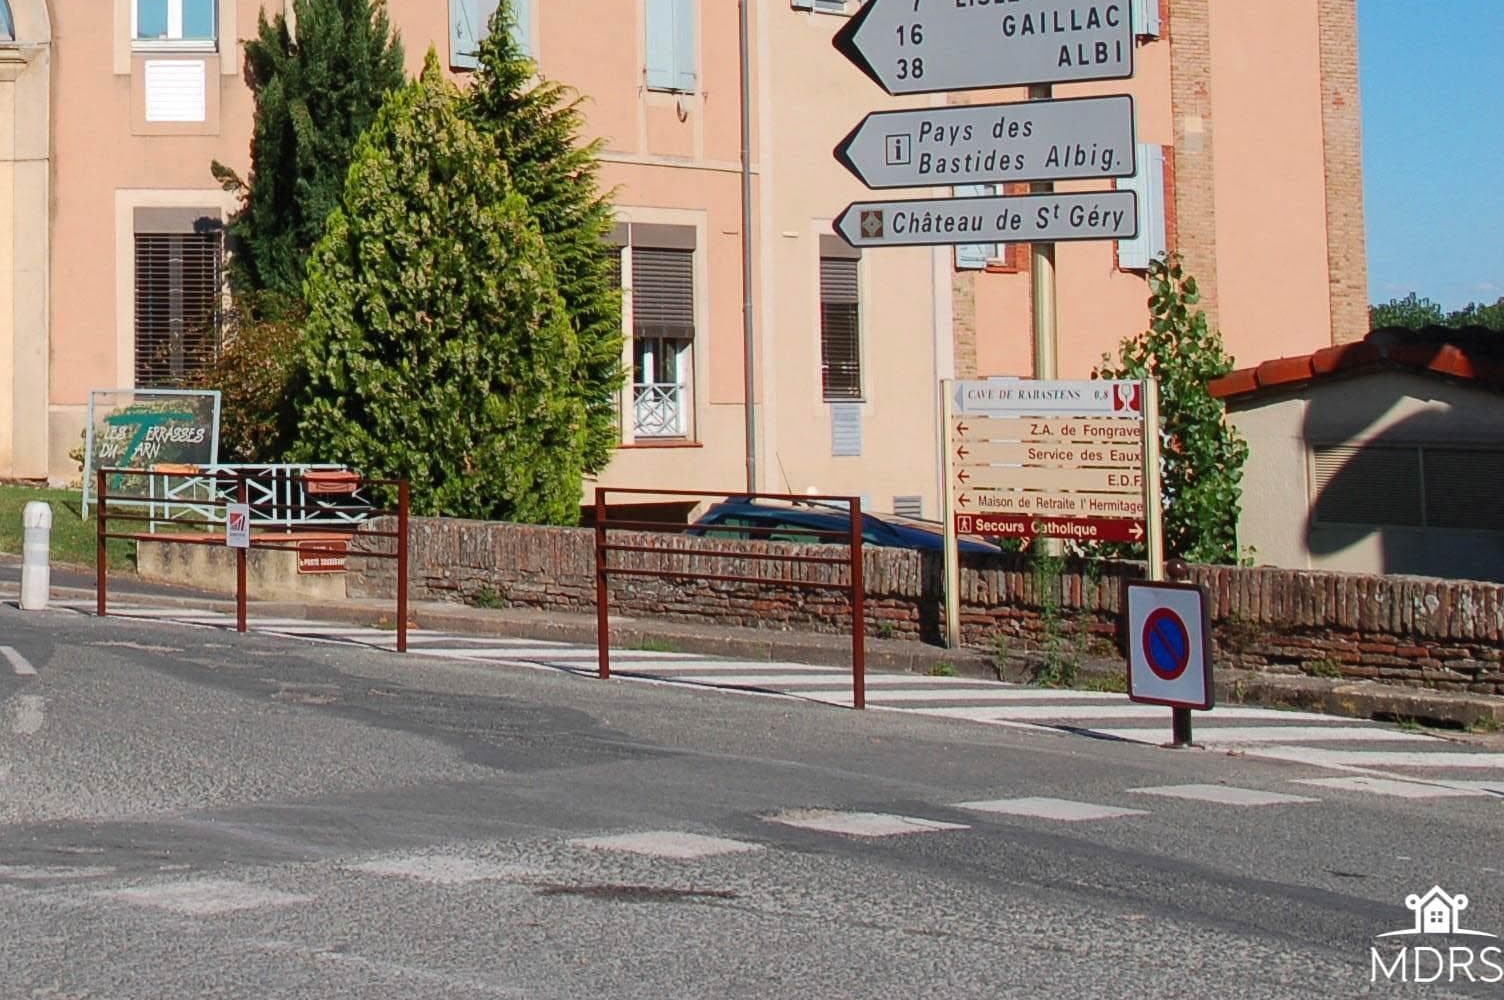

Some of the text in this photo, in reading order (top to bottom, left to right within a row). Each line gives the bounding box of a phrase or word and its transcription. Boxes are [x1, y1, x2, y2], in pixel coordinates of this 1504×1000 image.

[896, 5, 1120, 47] 16 GAILLAC
[896, 40, 1121, 80] 38 ALBI
[919, 116, 1033, 147] Pays des
[919, 143, 1121, 175] Bastides Albig.
[892, 211, 983, 234] Château
[996, 209, 1022, 231] de
[1069, 203, 1124, 233] Géry
[968, 389, 992, 400] CAVE
[999, 389, 1012, 400] DE
[1018, 389, 1081, 400] RABASTENS
[1030, 423, 1142, 439] Z.A. de Fongrave
[1028, 448, 1142, 462] Service des Eaux
[978, 495, 1013, 508] Maison
[1018, 496, 1031, 508] de
[1036, 496, 1076, 510] Retraite
[975, 518, 1025, 533] Secours
